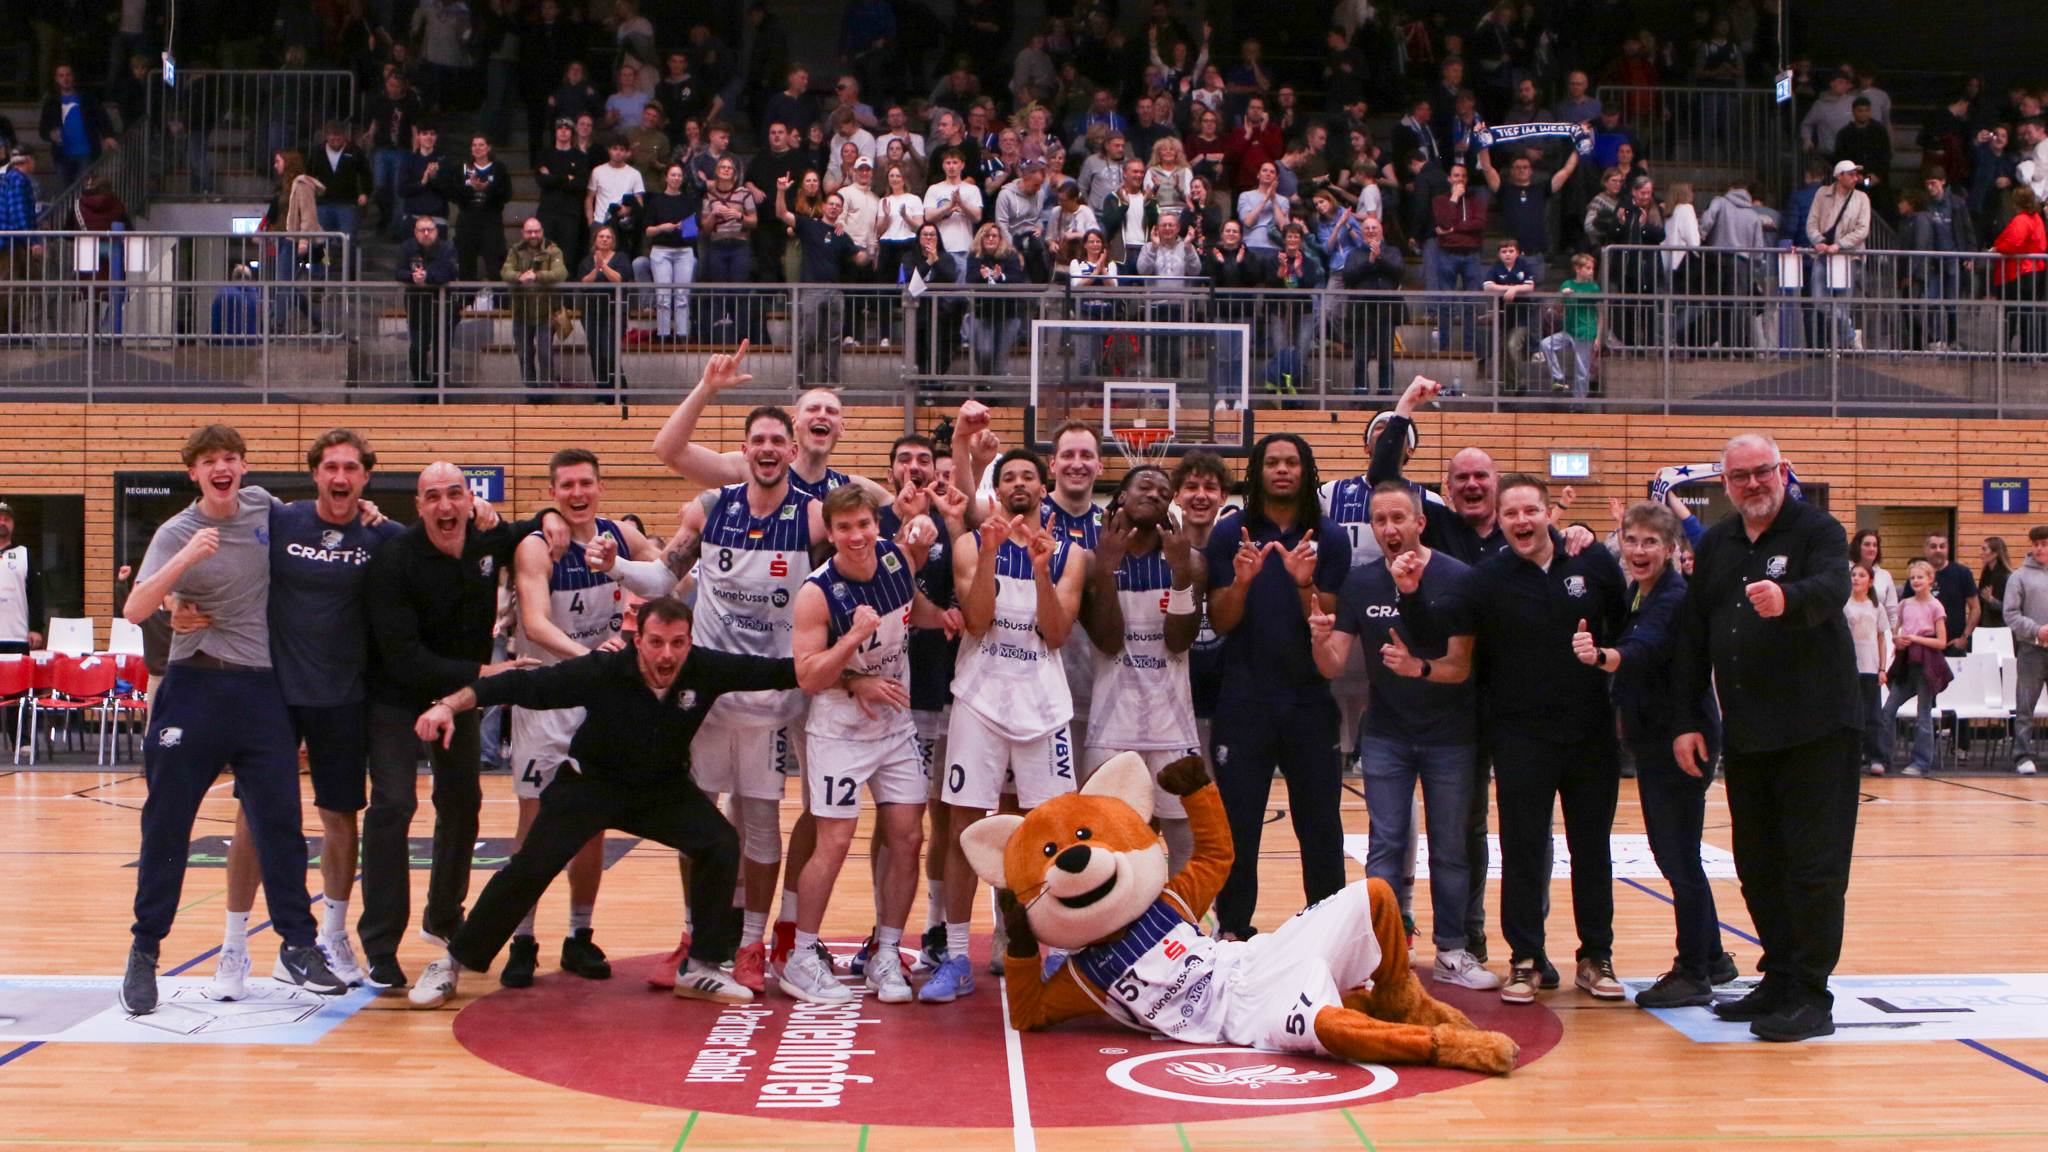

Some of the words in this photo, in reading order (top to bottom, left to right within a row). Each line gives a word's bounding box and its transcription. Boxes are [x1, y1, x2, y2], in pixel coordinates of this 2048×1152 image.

[1496, 127, 1519, 138] TIEF
[1522, 126, 1537, 134] IM
[125, 487, 171, 495] REGIERAUM
[470, 478, 489, 500] H
[286, 543, 354, 562] CRAFT
[719, 548, 733, 572] 8
[569, 592, 585, 615] 4
[712, 586, 769, 603] brunebusse
[775, 726, 788, 775] VBW
[1055, 727, 1071, 779] VBW
[522, 759, 543, 787] 4
[949, 764, 965, 793] 0
[823, 775, 857, 806] 12
[1114, 967, 1150, 1002] 57
[704, 1010, 774, 1047] Partner
[755, 985, 882, 1108] schenhofen
[684, 1048, 758, 1083] GmbH
